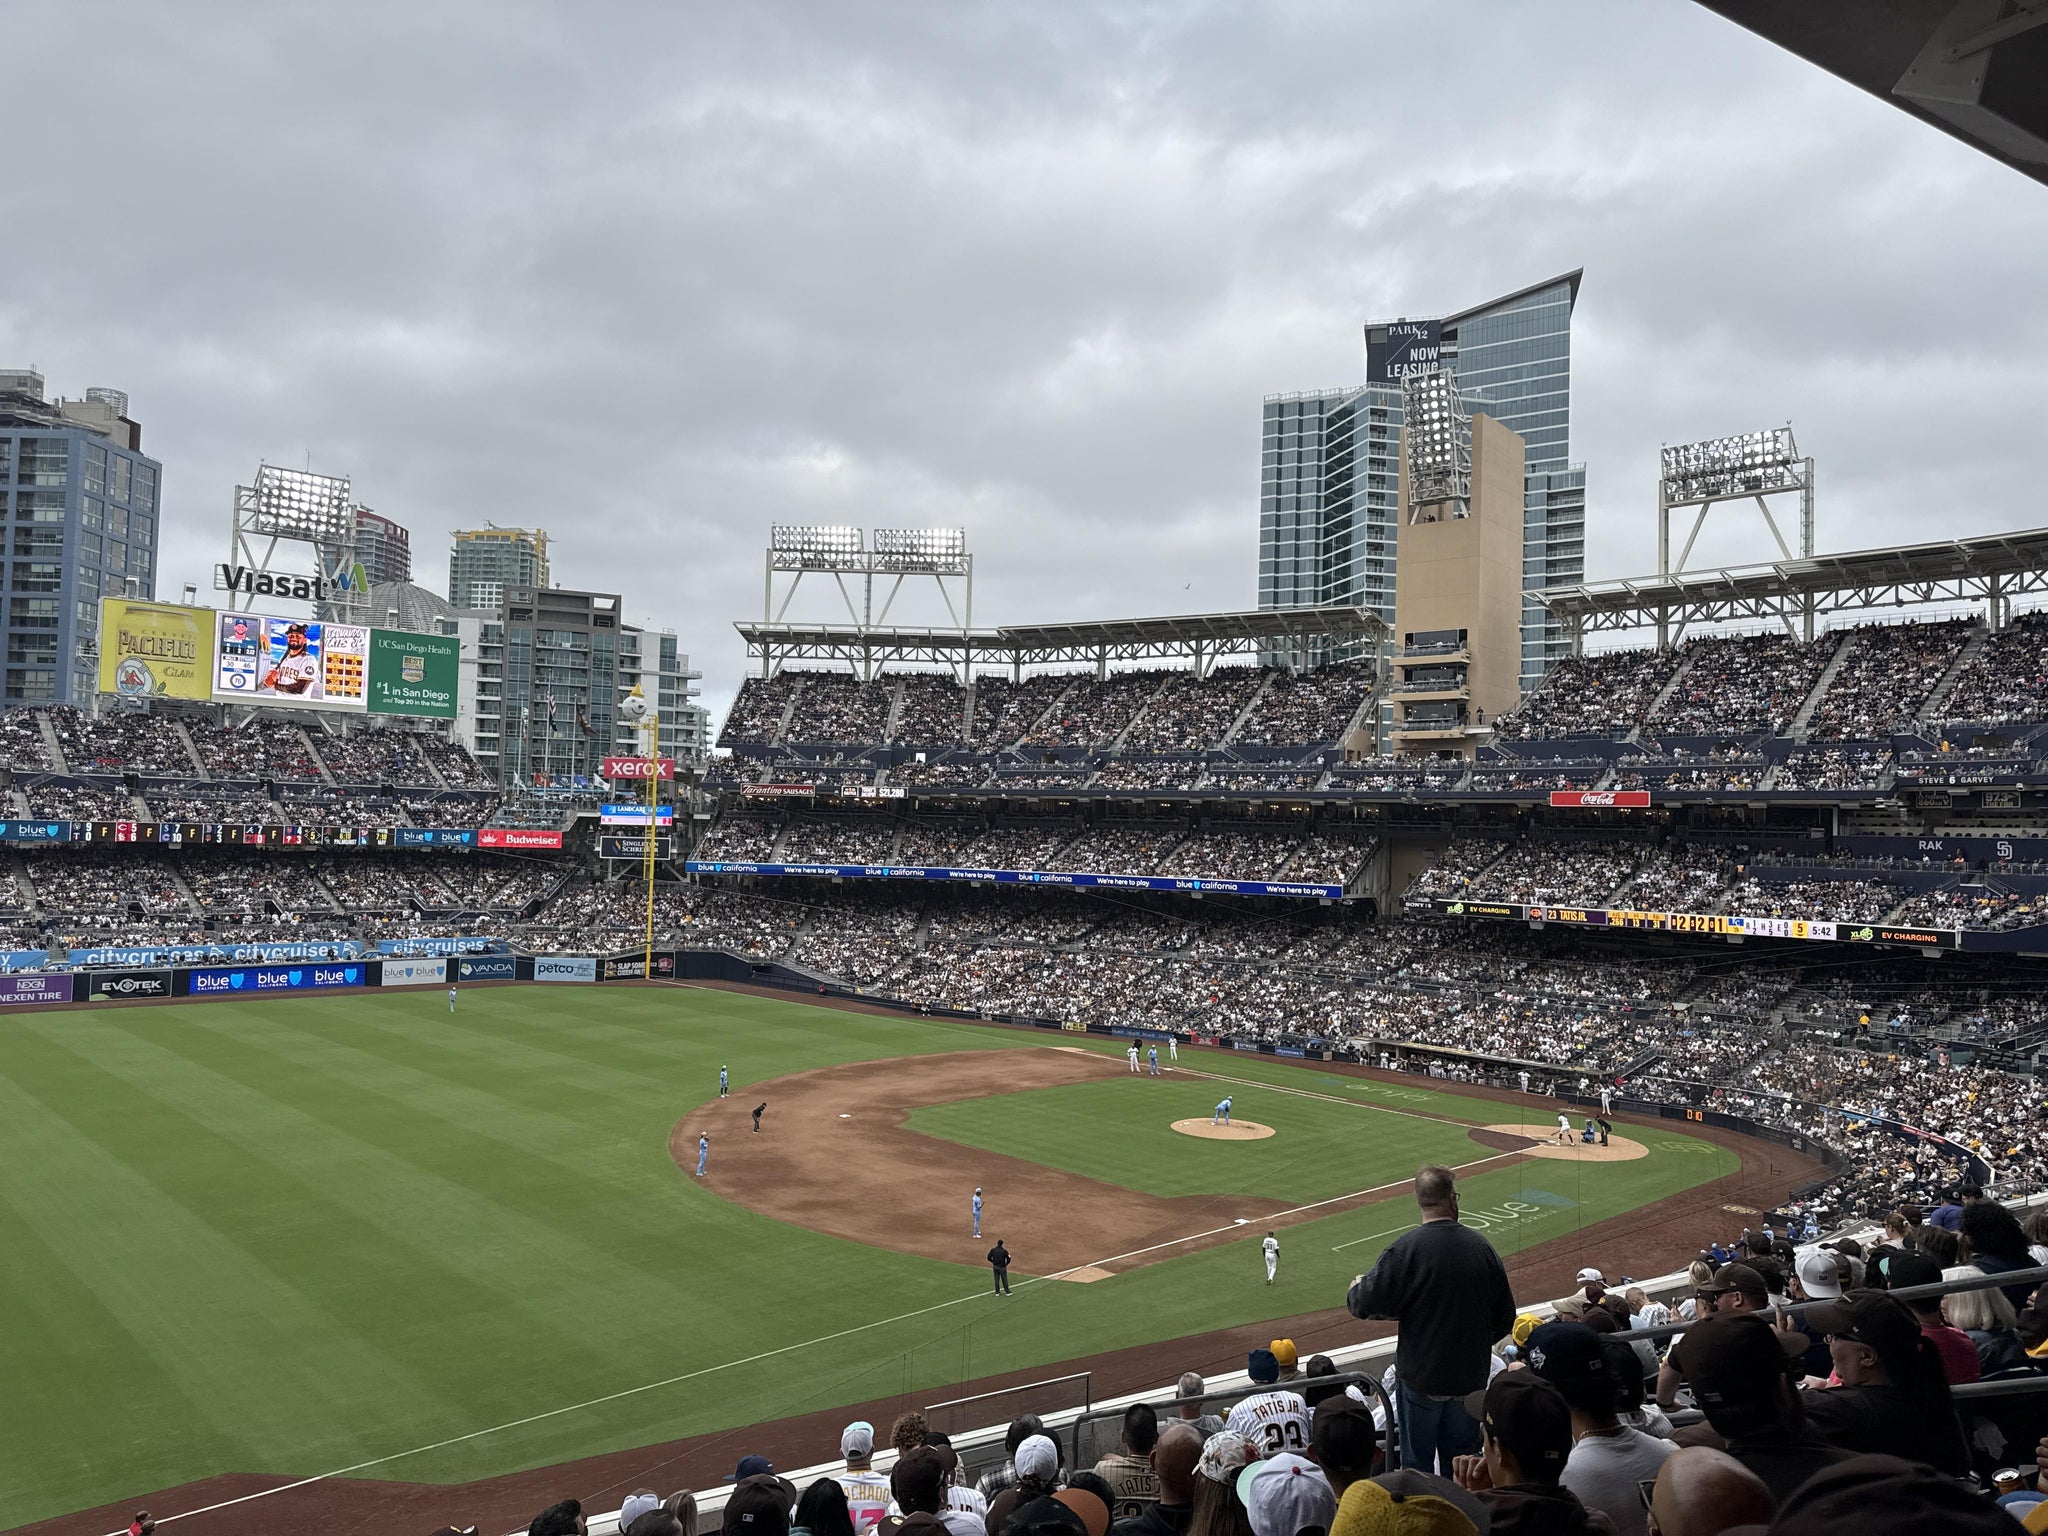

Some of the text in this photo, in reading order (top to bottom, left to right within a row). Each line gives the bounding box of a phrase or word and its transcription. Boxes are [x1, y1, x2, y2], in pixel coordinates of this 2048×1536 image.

[1389, 324, 1419, 336] PARK
[1416, 330, 1428, 340] 12
[1410, 346, 1439, 362] NOW
[1387, 361, 1439, 378] LEASING
[222, 563, 326, 601] Viasat
[118, 630, 197, 659] PACIFICO
[378, 639, 451, 655] UC San Diego Health
[404, 657, 422, 665] BEST
[376, 682, 450, 700] #1 in San Diego
[611, 762, 667, 776] xerox
[1949, 776, 1956, 784] 6
[1960, 776, 1994, 784] GARVEY
[742, 785, 782, 795] Tarantino
[879, 788, 904, 798] $21,280
[19, 824, 46, 834] blue
[102, 827, 108, 837] F
[146, 828, 153, 838] F
[190, 828, 196, 838] F
[231, 829, 237, 839] F
[271, 830, 277, 840] F
[404, 832, 424, 841] blue
[441, 833, 462, 841] blue
[505, 834, 559, 846] Budweiser
[1919, 840, 1943, 850] RAK
[722, 864, 758, 872] california
[890, 868, 925, 876] california
[984, 872, 996, 880] play
[1018, 873, 1073, 883] blue california
[1176, 880, 1238, 891] blue california
[1286, 886, 1302, 894] here
[1311, 887, 1328, 897] play
[1478, 907, 1511, 915] CHARGING
[1547, 909, 1557, 919] 23
[1560, 910, 1577, 920] TATIS
[1632, 919, 1640, 927] 13
[1652, 920, 1660, 928] 31
[1679, 916, 1686, 930] 2
[1698, 917, 1705, 930] 2
[1718, 918, 1723, 932] 1
[1745, 922, 1750, 930] R
[1769, 921, 1773, 929] 3
[1778, 924, 1781, 932] E
[1769, 928, 1773, 936] 5
[1784, 929, 1789, 937] 0
[1797, 923, 1803, 934] 5
[1812, 927, 1831, 936] 5:42
[1893, 933, 1937, 942] CHARGING
[384, 966, 436, 976] blue blue
[473, 963, 514, 972] VANDA
[538, 963, 574, 975] petco
[198, 973, 229, 987] blue
[258, 971, 288, 984] blue
[315, 970, 344, 982] blue
[102, 978, 162, 992] EVOTEK
[0, 991, 62, 1002] NEXEN TIRE
[1487, 1209, 1559, 1235] CALIFORNIA
[1252, 1400, 1302, 1421] TATIS JR.
[1265, 1420, 1303, 1452] 23
[1118, 1476, 1152, 1498] TATIS
[843, 1485, 889, 1504] ACHADO
